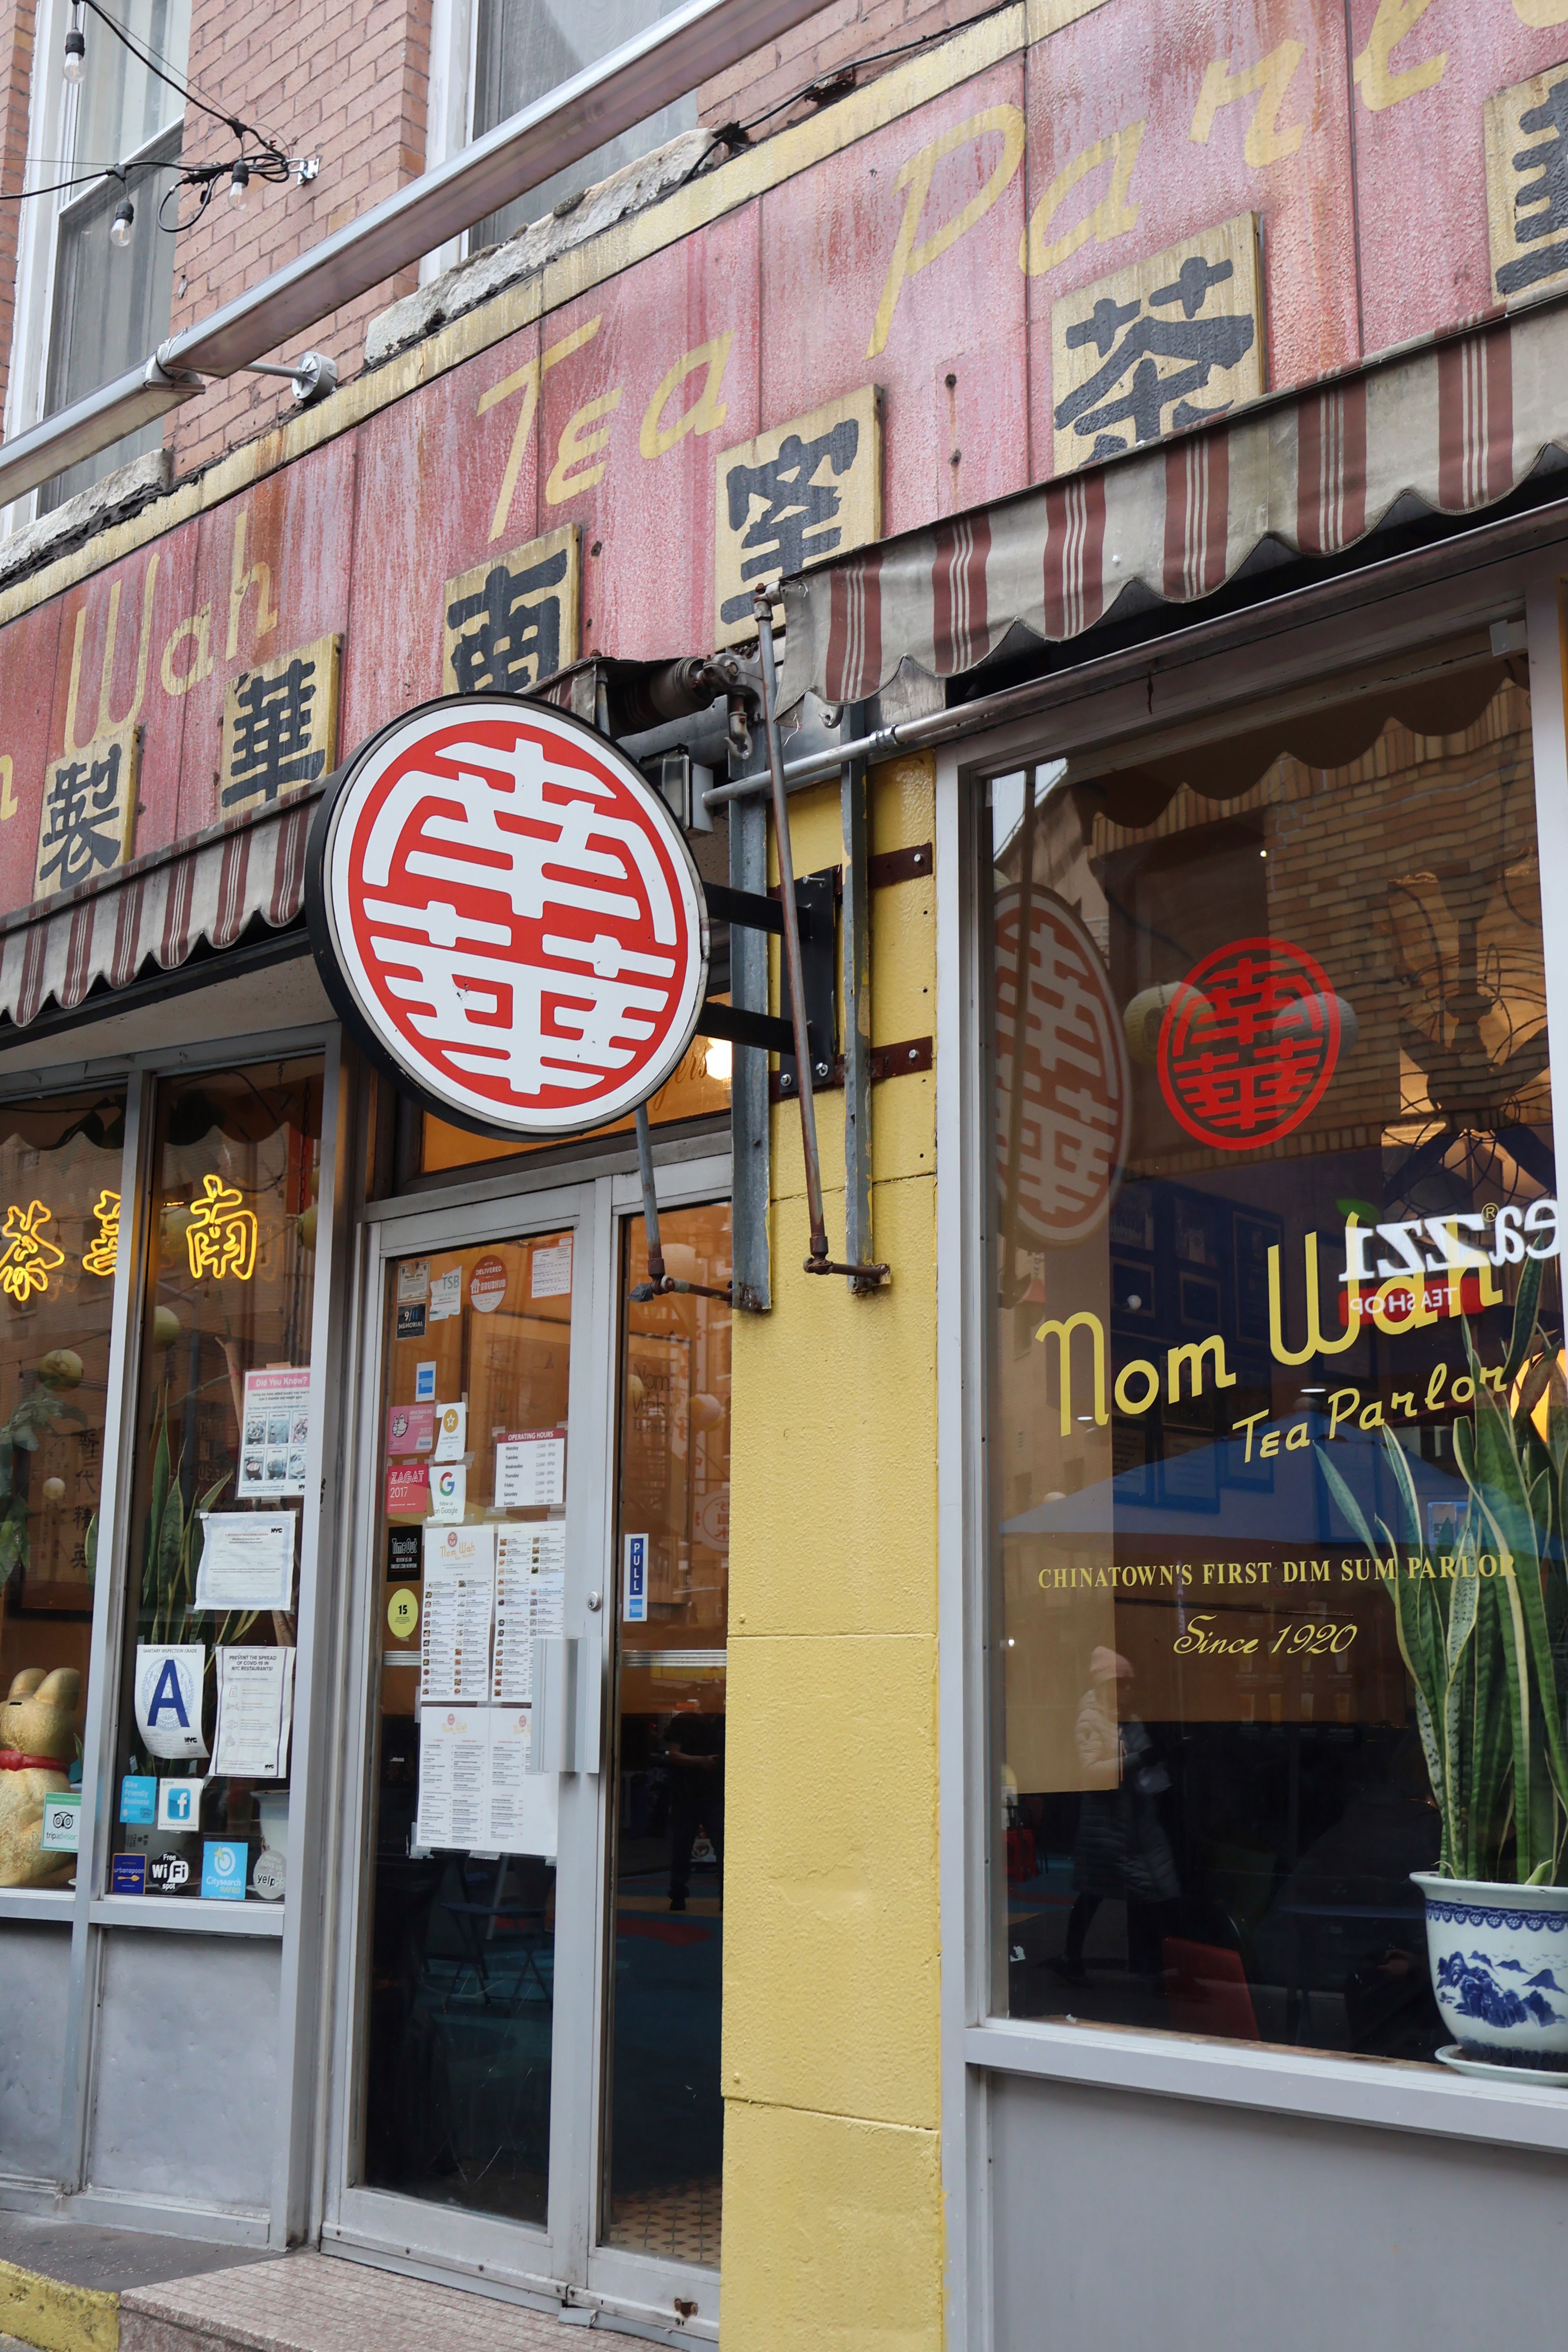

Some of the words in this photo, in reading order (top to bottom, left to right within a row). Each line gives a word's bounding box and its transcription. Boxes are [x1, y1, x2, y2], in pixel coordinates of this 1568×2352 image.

[65, 512, 278, 755] Wah
[477, 314, 735, 544] Tea
[221, 659, 325, 808] 華
[475, 1266, 502, 1276] DELIVERED
[442, 1275, 459, 1290] TSB
[481, 1279, 506, 1291] GRUBHUB
[398, 1321, 423, 1330] MEMORIAL
[1035, 1312, 1236, 1437] Nom
[1268, 1211, 1503, 1366] Wah
[284, 1376, 307, 1385] Know?
[1232, 1408, 1310, 1463] Tea
[1328, 1363, 1507, 1439] Parlor
[508, 1432, 536, 1441] OPERATING
[390, 1470, 425, 1484] ZAGAT
[390, 1487, 408, 1498] 2017
[441, 1507, 458, 1515] Google
[440, 1545, 456, 1558] Nom
[459, 1541, 475, 1553] Wah
[1038, 1564, 1193, 1589] CHINATOWN'S
[1202, 1561, 1273, 1584] FIRST
[1287, 1560, 1331, 1583] DIM
[1341, 1558, 1396, 1581] SUM
[1408, 1554, 1517, 1579] PARLOR
[398, 1605, 407, 1615] 15
[1173, 1614, 1259, 1654] Since
[1271, 1624, 1358, 1653] 1920
[147, 1660, 190, 1727] A
[207, 1876, 241, 1887] Citysearch
[257, 1874, 275, 1887] yelp
